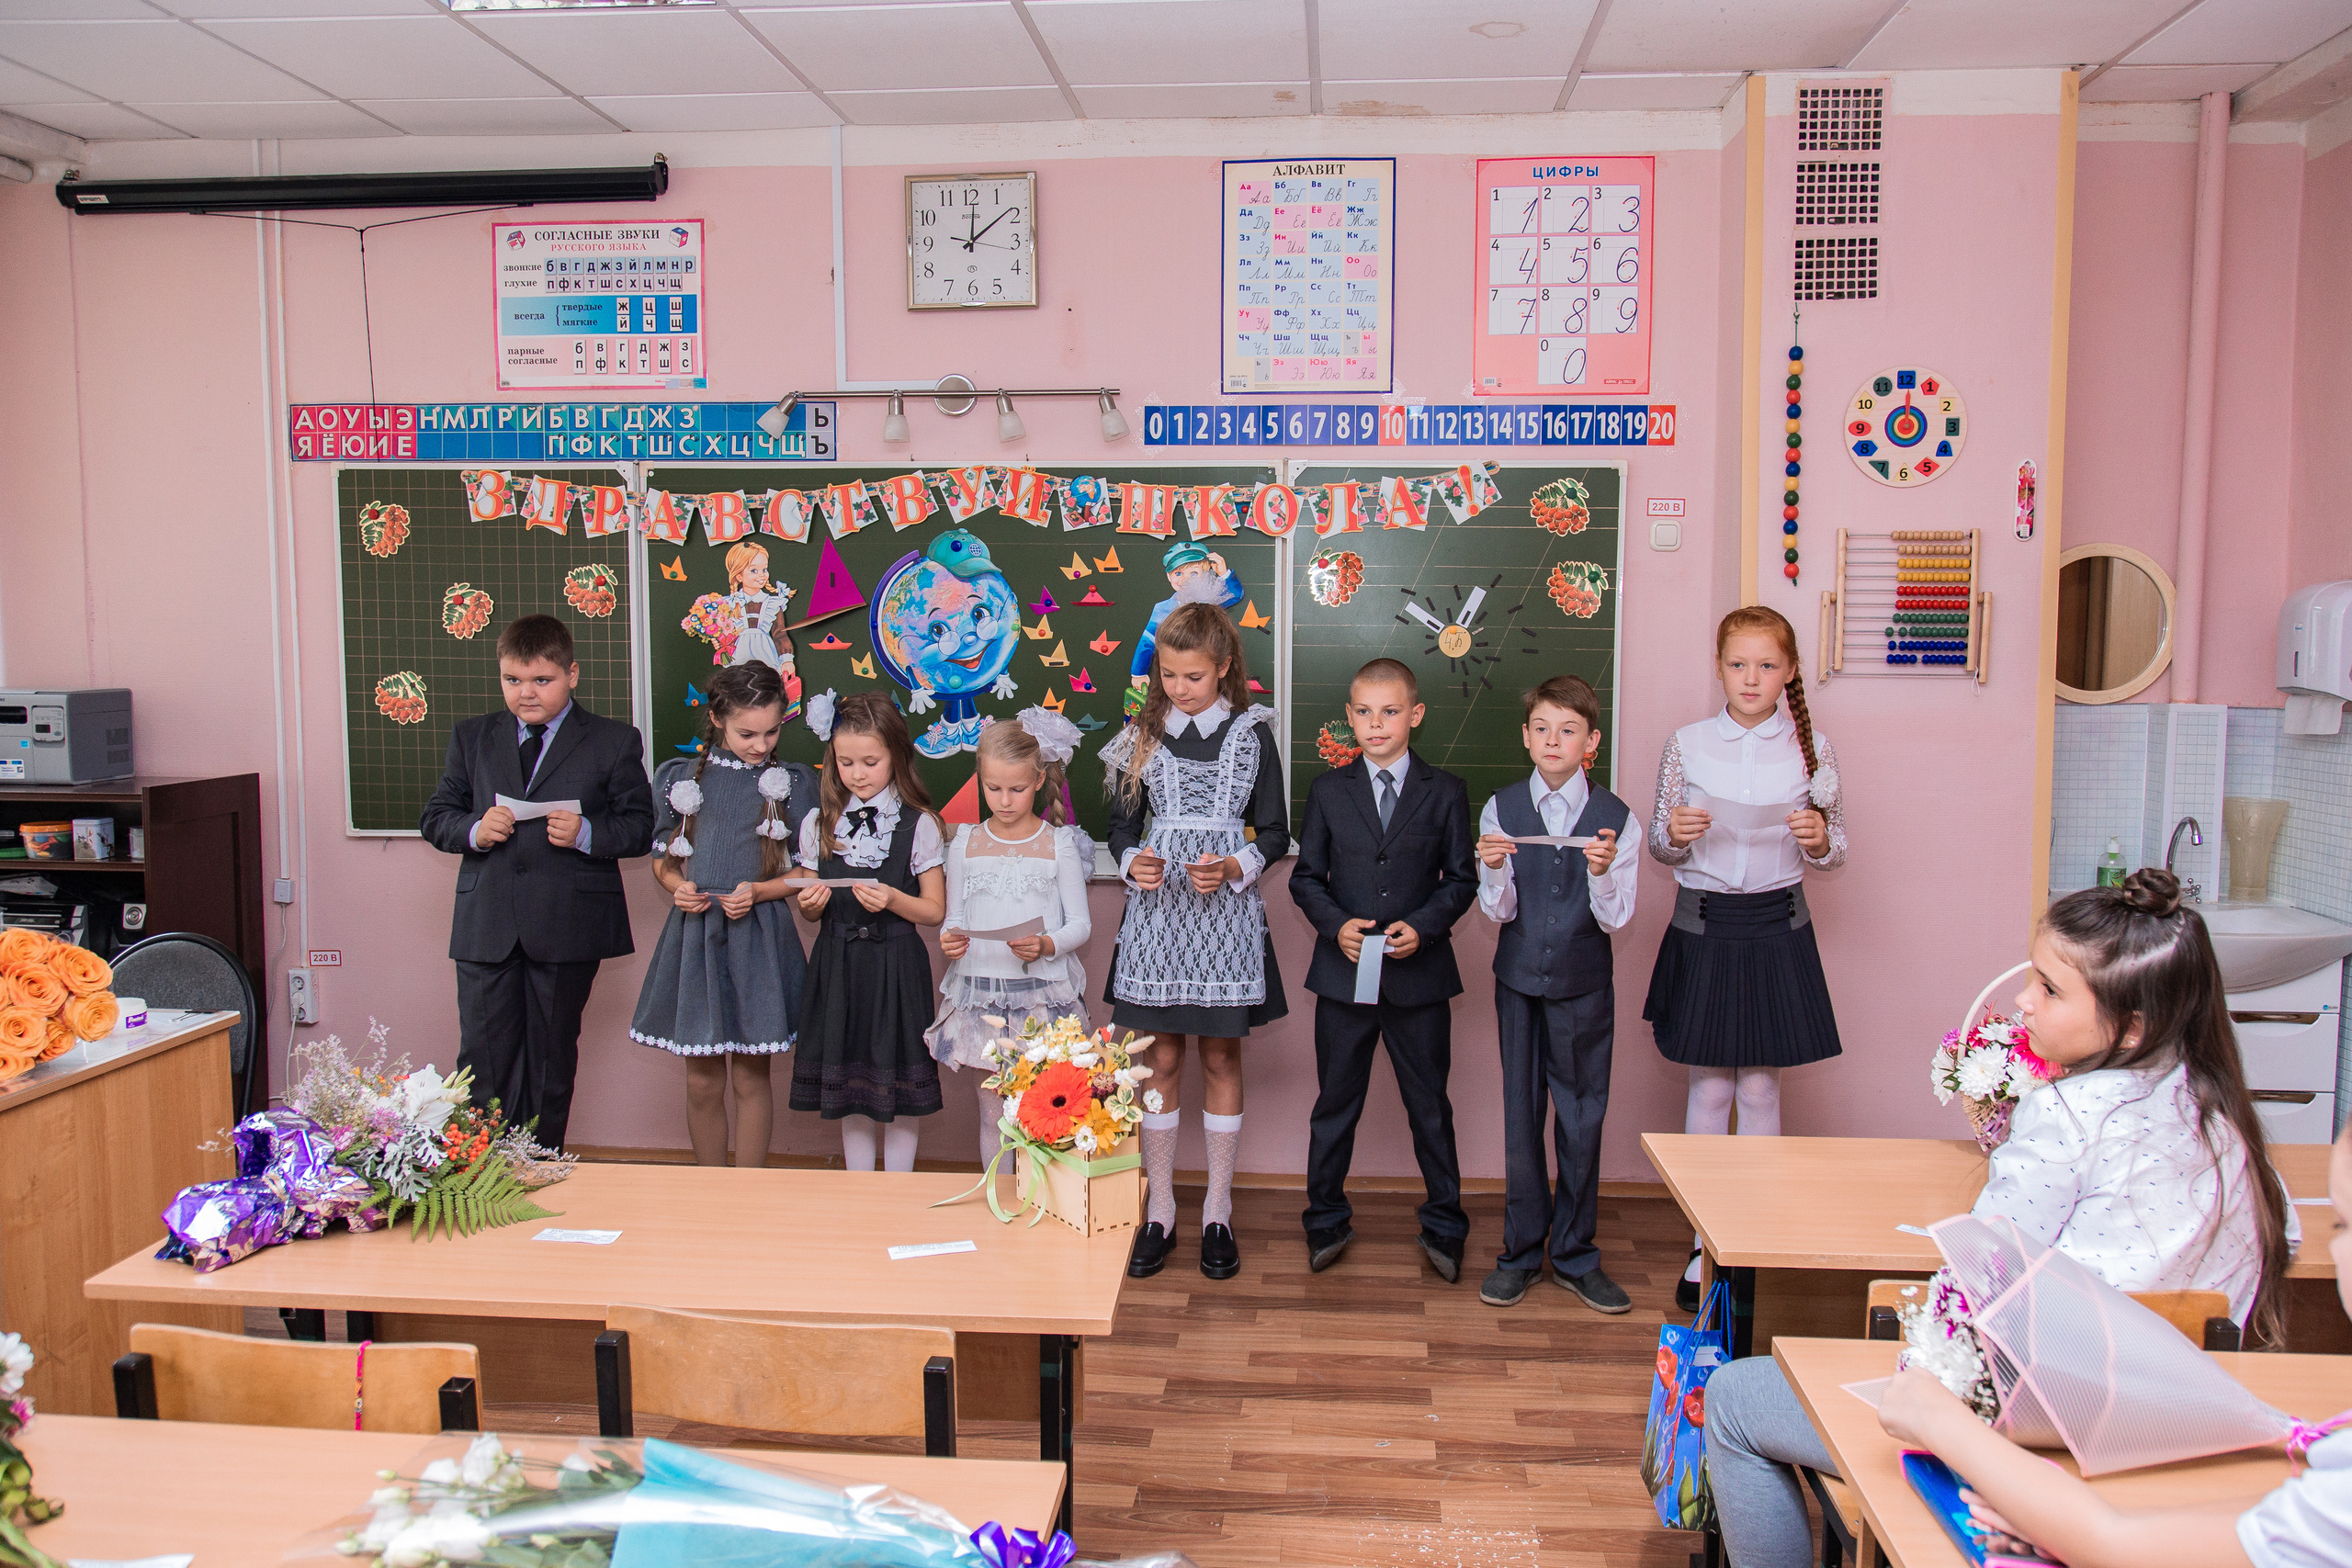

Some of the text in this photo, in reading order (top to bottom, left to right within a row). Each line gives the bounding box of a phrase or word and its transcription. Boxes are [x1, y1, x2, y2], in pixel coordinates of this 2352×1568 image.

[1272, 164, 1346, 176] АЛФАВИТ
[1533, 166, 1599, 179] ЦИФРЫ
[940, 189, 953, 207] 11
[964, 189, 978, 206] 12
[994, 188, 999, 205] 1
[1493, 189, 1499, 201] 1
[1544, 188, 1551, 199] 2
[1595, 188, 1601, 199] 3
[921, 209, 935, 226] 10
[1010, 208, 1020, 223] 2
[1522, 197, 1538, 233] 1
[1568, 197, 1589, 232] 2
[1619, 197, 1640, 232] 3
[535, 230, 660, 241] СОГЛАСНЫЕ ЗВУКИ
[1011, 233, 1020, 250] 3
[551, 243, 605, 252] РУССКОГО
[923, 236, 933, 253] 9
[1491, 239, 1499, 251] 4
[1544, 239, 1551, 250] 5
[1593, 238, 1601, 250] 6
[503, 264, 542, 272] звонкие
[924, 262, 934, 278] 8
[1011, 259, 1021, 276] 4
[1519, 248, 1537, 284] 4
[1567, 247, 1588, 283] 5
[1617, 247, 1639, 283] 6
[504, 279, 537, 288] глухие
[944, 279, 954, 296] 7
[968, 279, 978, 296] 6
[992, 278, 1002, 295] 5
[1275, 284, 1286, 293] Рр
[1491, 289, 1498, 301] 7
[1542, 289, 1550, 300] 8
[1592, 288, 1600, 299] 9
[514, 312, 545, 321] всегда
[1518, 299, 1536, 334] 7
[1565, 298, 1588, 333] 8
[1615, 298, 1637, 333] 9
[563, 319, 597, 327] мягкие
[508, 347, 544, 355] парные
[1541, 340, 1549, 351] 0
[508, 356, 558, 365] согласные
[1564, 348, 1586, 384] 0
[1875, 382, 1889, 391] 11
[1899, 376, 1914, 385] 12
[1927, 382, 1934, 391] 1
[1858, 400, 1872, 409] 10
[1942, 401, 1951, 411] 2
[1149, 412, 1674, 439] 0 1 2 3 4 5 6 7 8 9 10 11 12 13 14 15 16 17 18 19 20
[1856, 423, 1864, 434] 9
[1948, 423, 1956, 433] 3
[1860, 444, 1869, 454] 8
[1939, 445, 1948, 454] 4
[1877, 463, 1885, 472] 7
[1923, 462, 1931, 472] 5
[1899, 468, 1907, 479] 6
[472, 465, 1480, 543] ЗДРАВСТВУЙ ШКОЛА!
